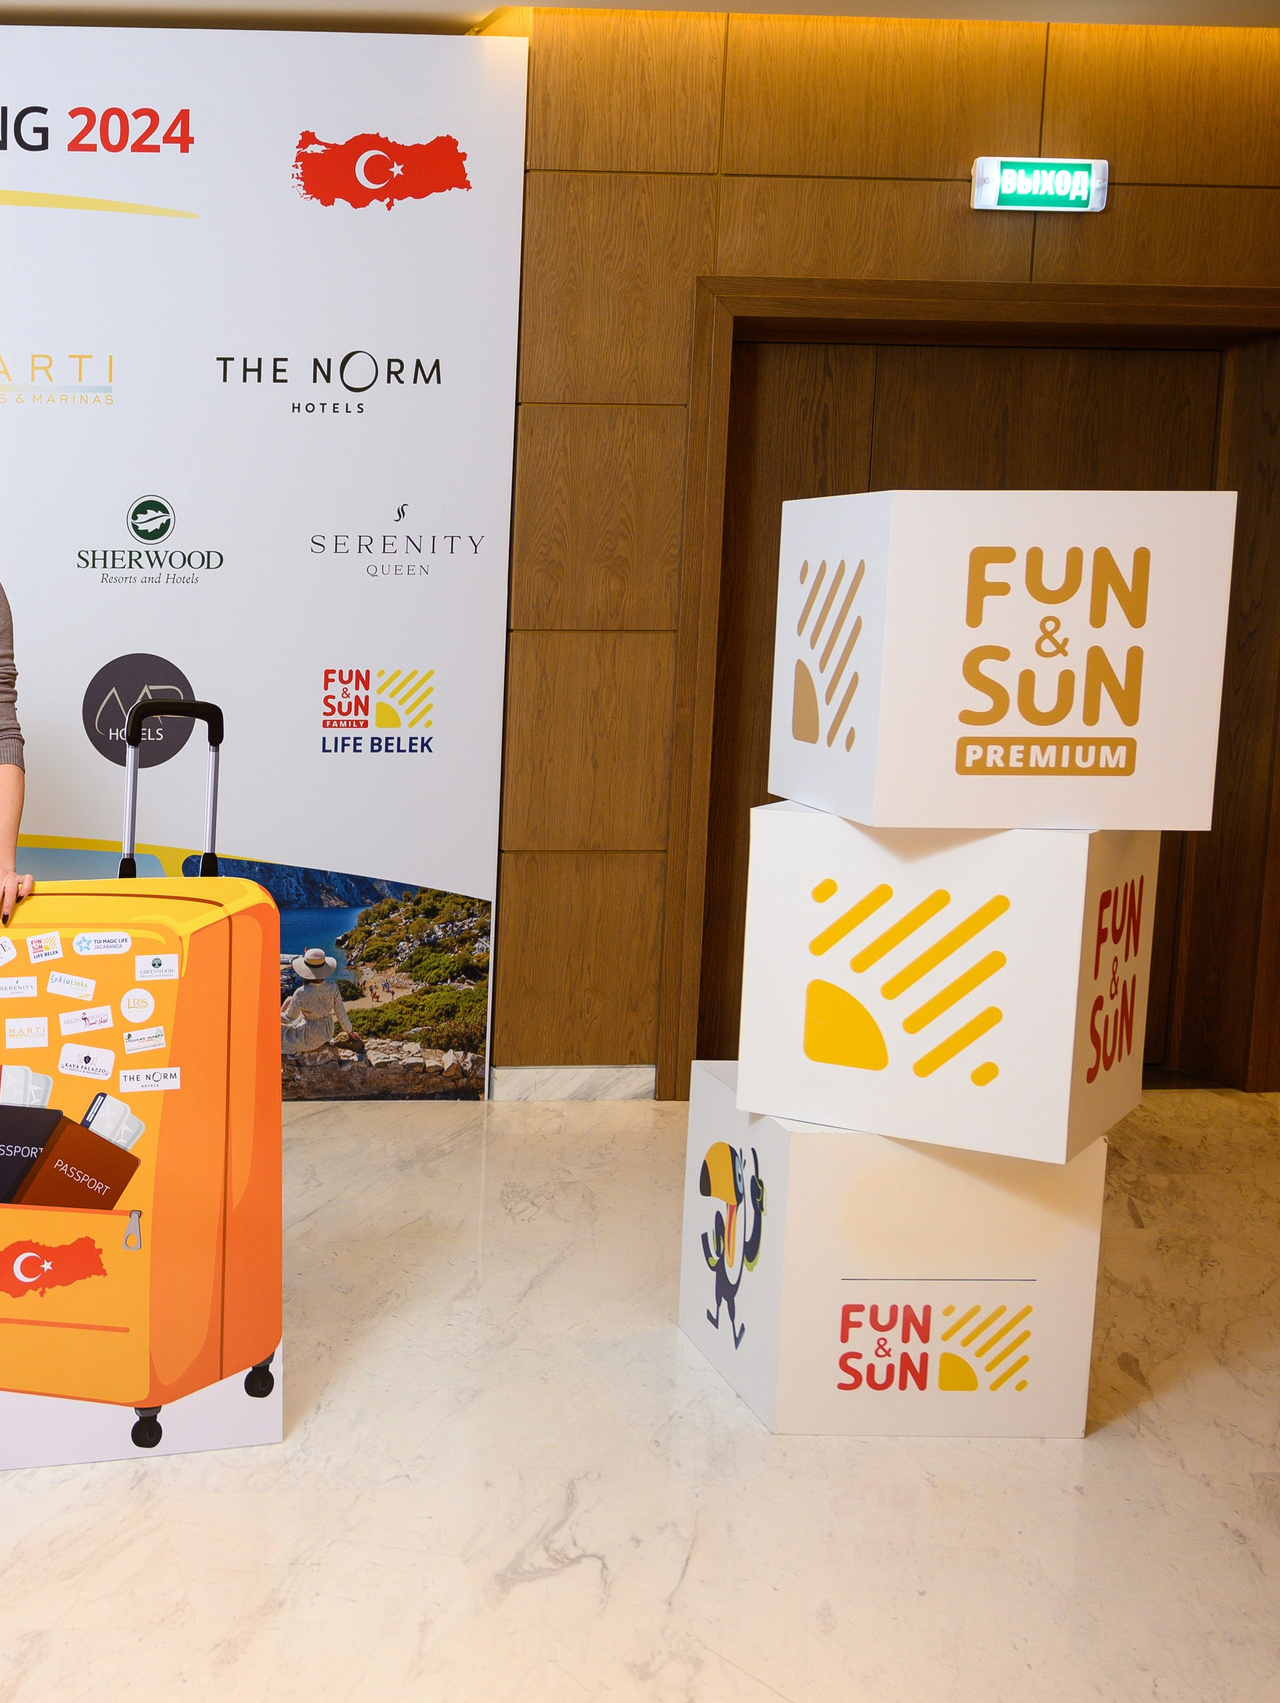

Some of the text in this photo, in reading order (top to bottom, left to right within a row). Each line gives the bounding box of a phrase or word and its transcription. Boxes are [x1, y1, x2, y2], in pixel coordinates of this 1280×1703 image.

[66, 106, 195, 154] 2024
[1001, 168, 1089, 201] ВЫХОД
[216, 350, 443, 393] THE NORM
[15, 393, 26, 405] &
[31, 393, 115, 406] MARINAS
[291, 402, 366, 414] HOTELS
[310, 534, 486, 555] SERENITY
[76, 550, 224, 570] SHERWOOD
[366, 564, 431, 577] QUEEN
[100, 572, 200, 585] Resorts and Hotels
[965, 546, 1151, 629] FUN
[1034, 615, 1070, 658] &
[323, 669, 371, 691] FUN
[958, 644, 1144, 727] SUN
[341, 687, 350, 698] &
[322, 694, 369, 716] SUN
[109, 728, 164, 741] HOELS
[321, 736, 434, 753] LIFE BELEK
[965, 744, 1127, 769] PREMIUM
[1093, 874, 1144, 981] FUN
[127, 998, 149, 1010] LRS
[8, 1026, 45, 1035] MARTI
[1086, 973, 1136, 1084] SUN
[80, 1065, 106, 1073] PALAZZO
[145, 1071, 177, 1082] NORM
[53, 1159, 111, 1196] PASSPORT
[840, 1304, 931, 1344] FUN
[874, 1337, 892, 1358] &
[837, 1351, 929, 1391] SUN
